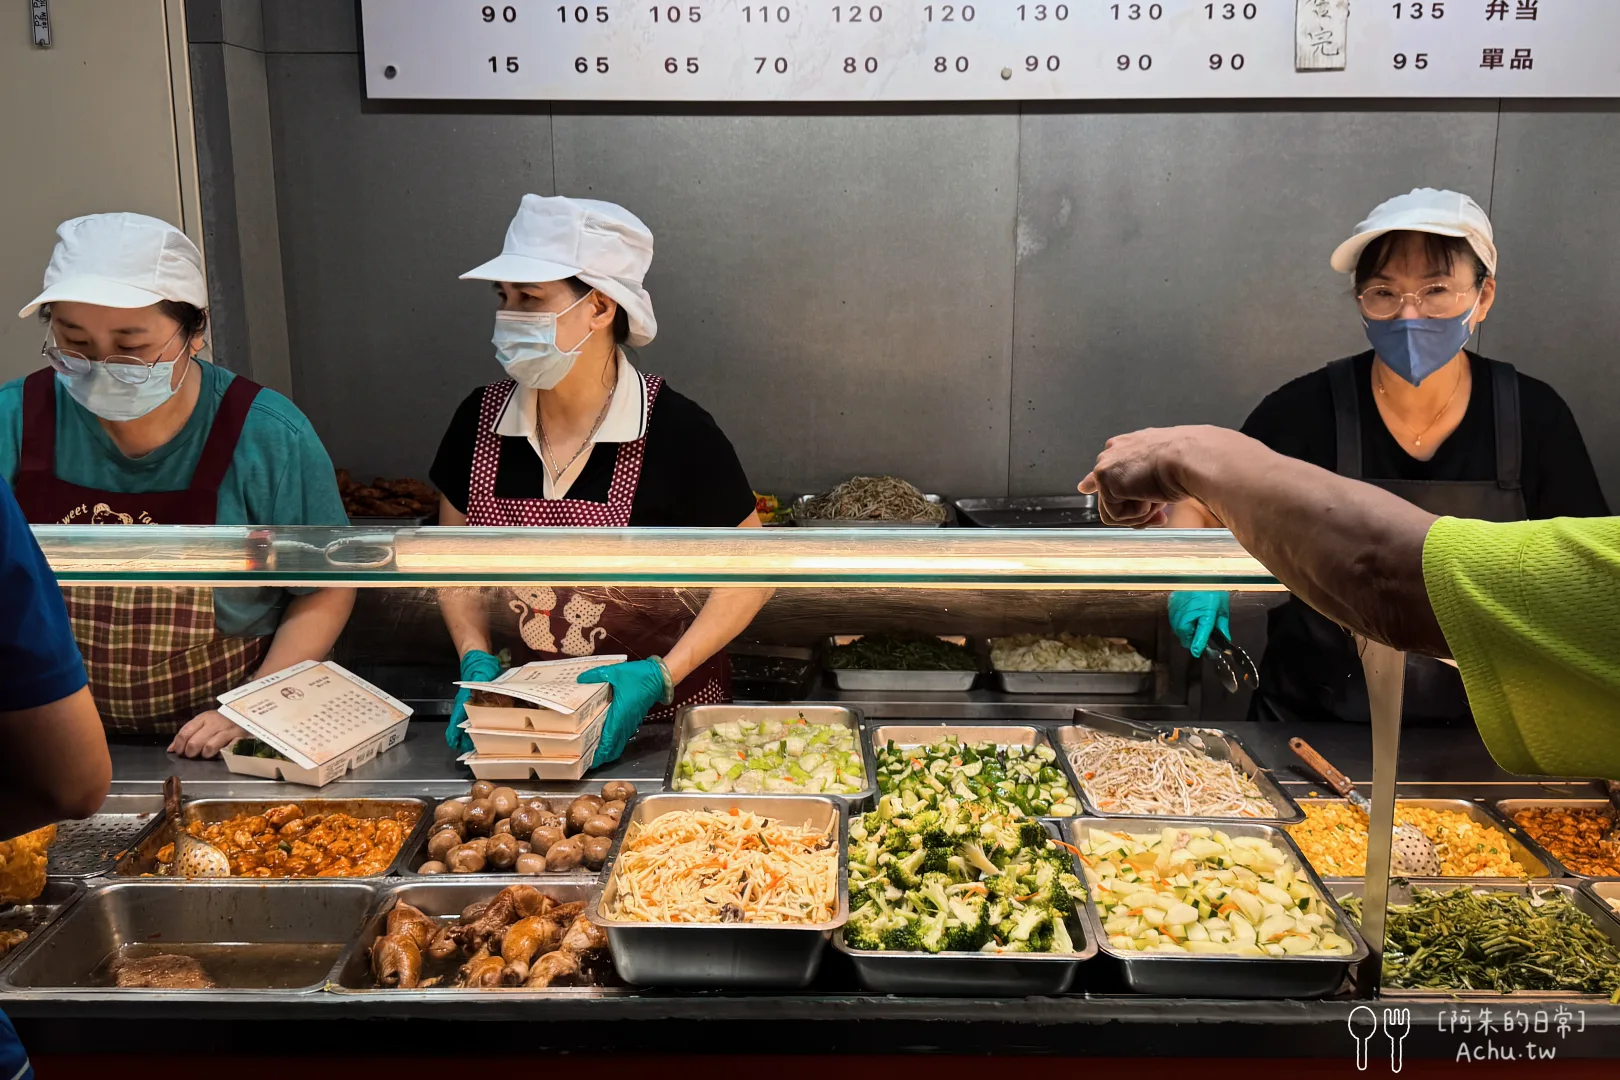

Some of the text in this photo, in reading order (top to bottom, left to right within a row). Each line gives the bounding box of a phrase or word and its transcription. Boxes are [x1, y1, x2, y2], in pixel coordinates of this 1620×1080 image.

[481, 5, 517, 23] 90
[557, 5, 609, 23] 105
[649, 6, 701, 23] 105
[742, 6, 790, 23] 110
[832, 6, 883, 22] 120
[924, 5, 975, 22] 120
[1017, 4, 1069, 21] 130
[1110, 3, 1163, 20] 130
[1204, 2, 1257, 20] 130
[1392, 2, 1445, 20] 135
[488, 47, 1534, 74] 15 65 65 70 80 80 90 90 90 95 單品
[56, 503, 88, 524] weet
